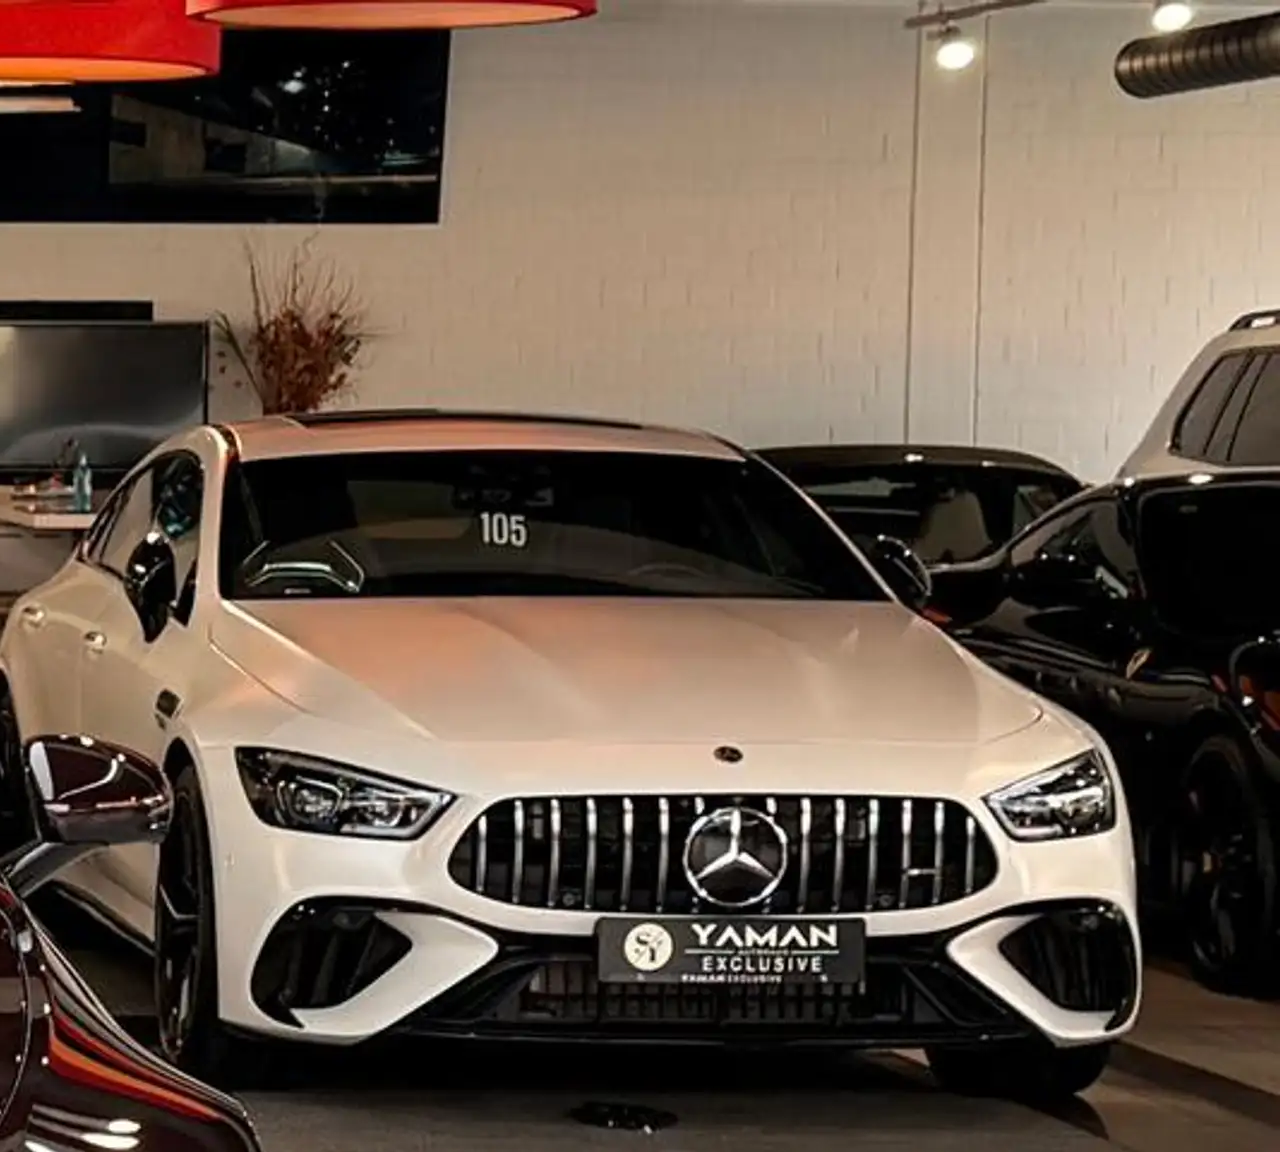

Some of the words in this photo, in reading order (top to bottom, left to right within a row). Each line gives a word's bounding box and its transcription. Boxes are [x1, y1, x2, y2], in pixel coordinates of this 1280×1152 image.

[480, 511, 528, 548] 105
[691, 922, 838, 948] YAMAN
[701, 955, 823, 973] EXCLUSIVE
